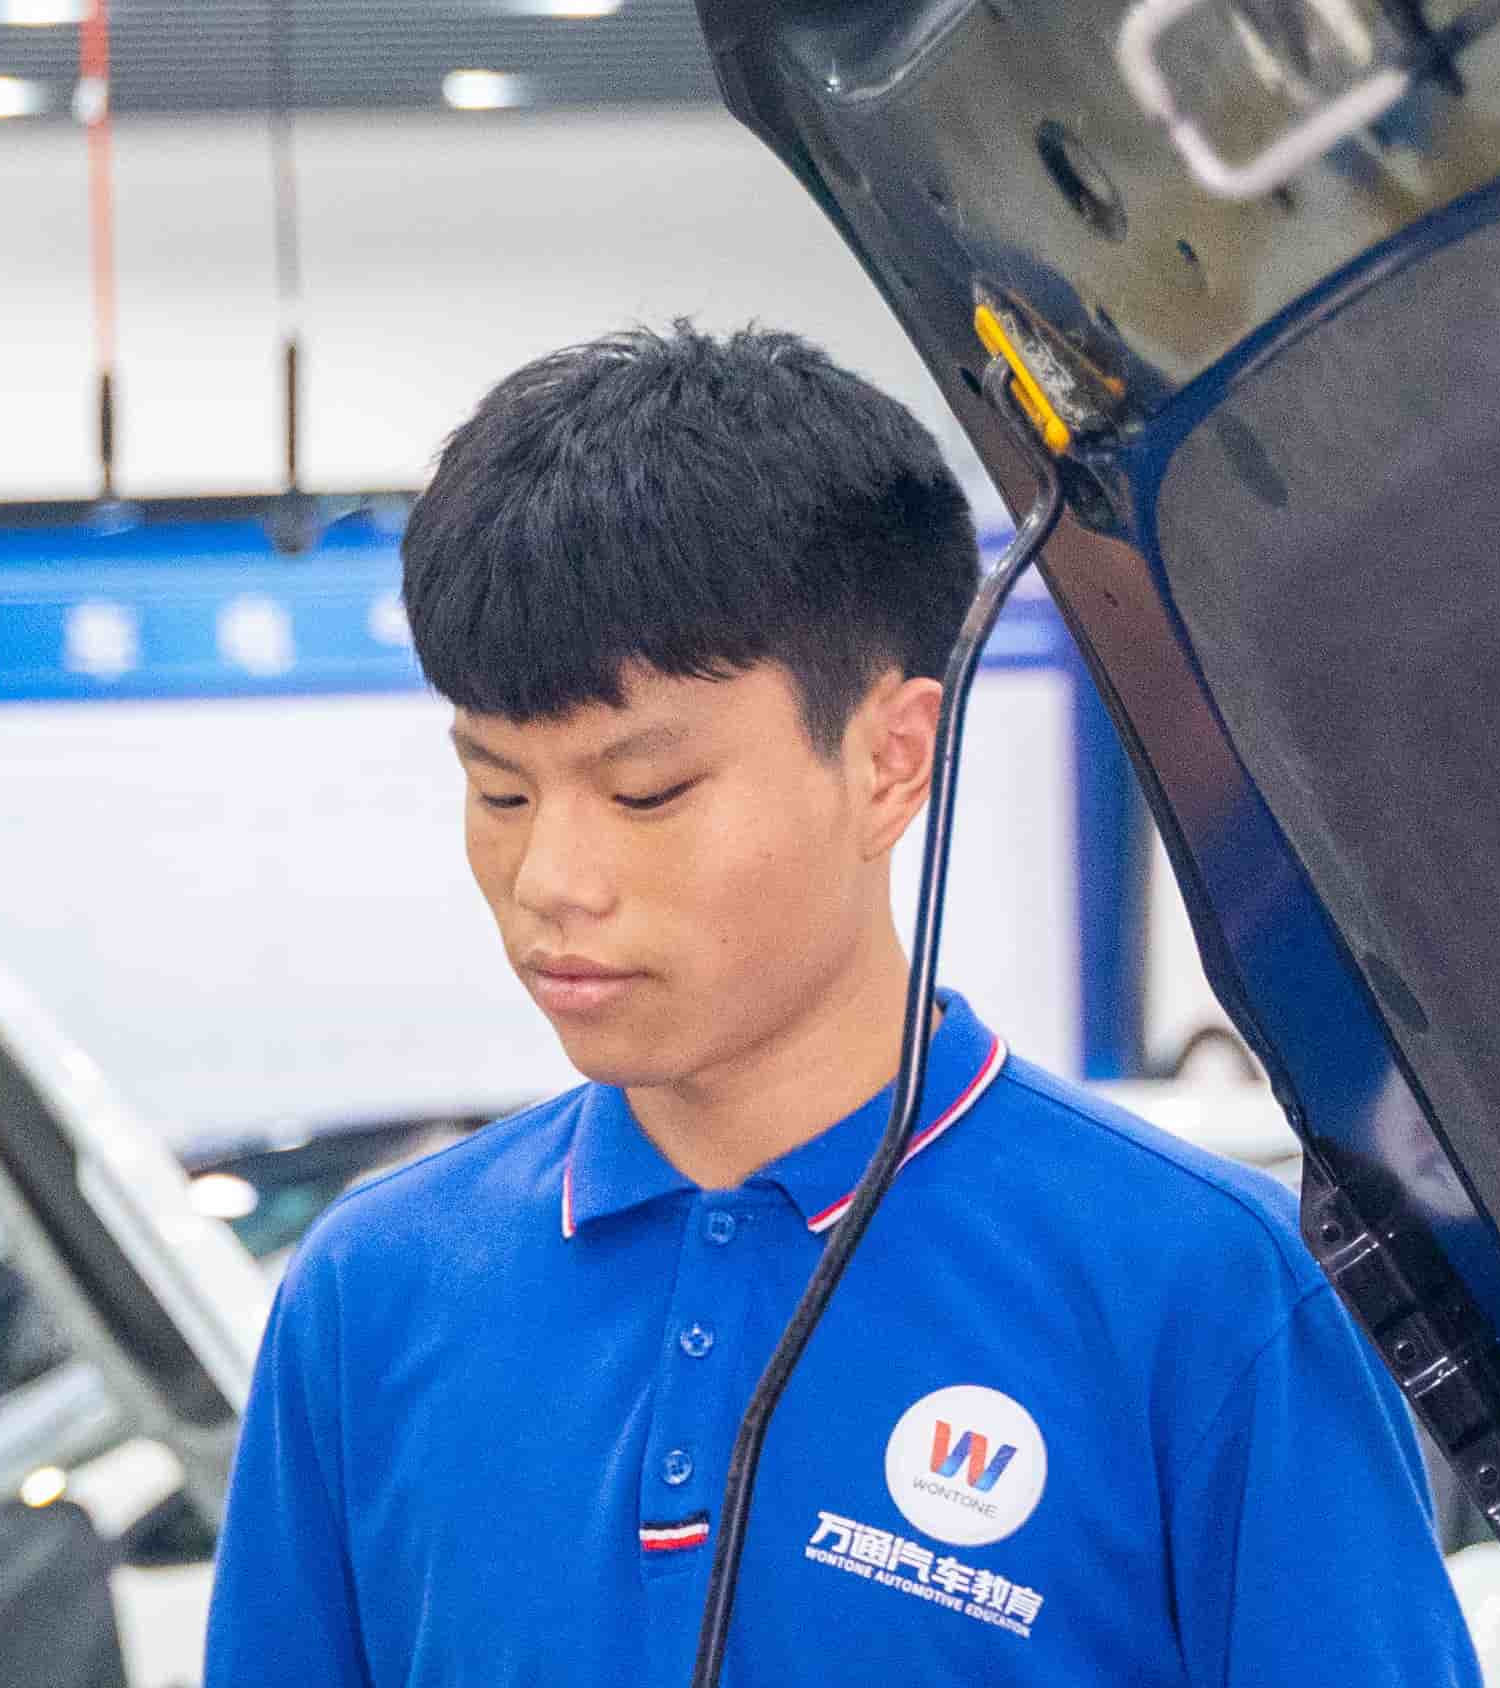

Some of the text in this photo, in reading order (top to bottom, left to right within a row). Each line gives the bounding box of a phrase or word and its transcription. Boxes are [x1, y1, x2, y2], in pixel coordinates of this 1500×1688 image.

[912, 1476, 998, 1519] WONTONE
[805, 1546, 874, 1579] WONTONE
[874, 1569, 964, 1612] AUTOMOTIVE
[809, 1511, 1044, 1625] 万通汽车教育
